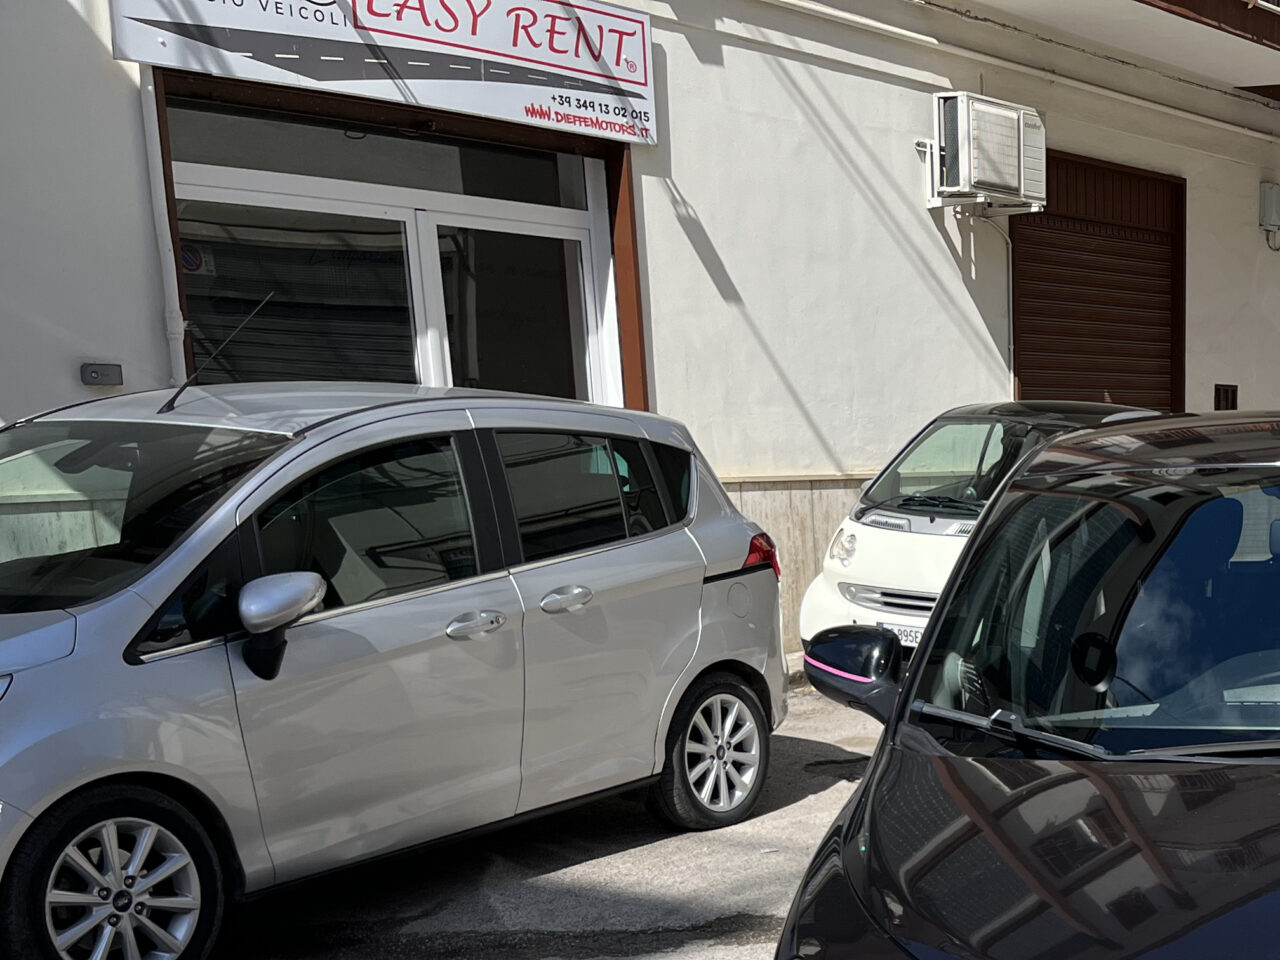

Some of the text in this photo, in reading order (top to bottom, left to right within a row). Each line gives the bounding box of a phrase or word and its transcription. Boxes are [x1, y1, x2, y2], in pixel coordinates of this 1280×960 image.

[259, 0, 348, 28] VEICOLI
[506, 6, 637, 67] RENT
[551, 94, 650, 122] +39 349 13 02 015
